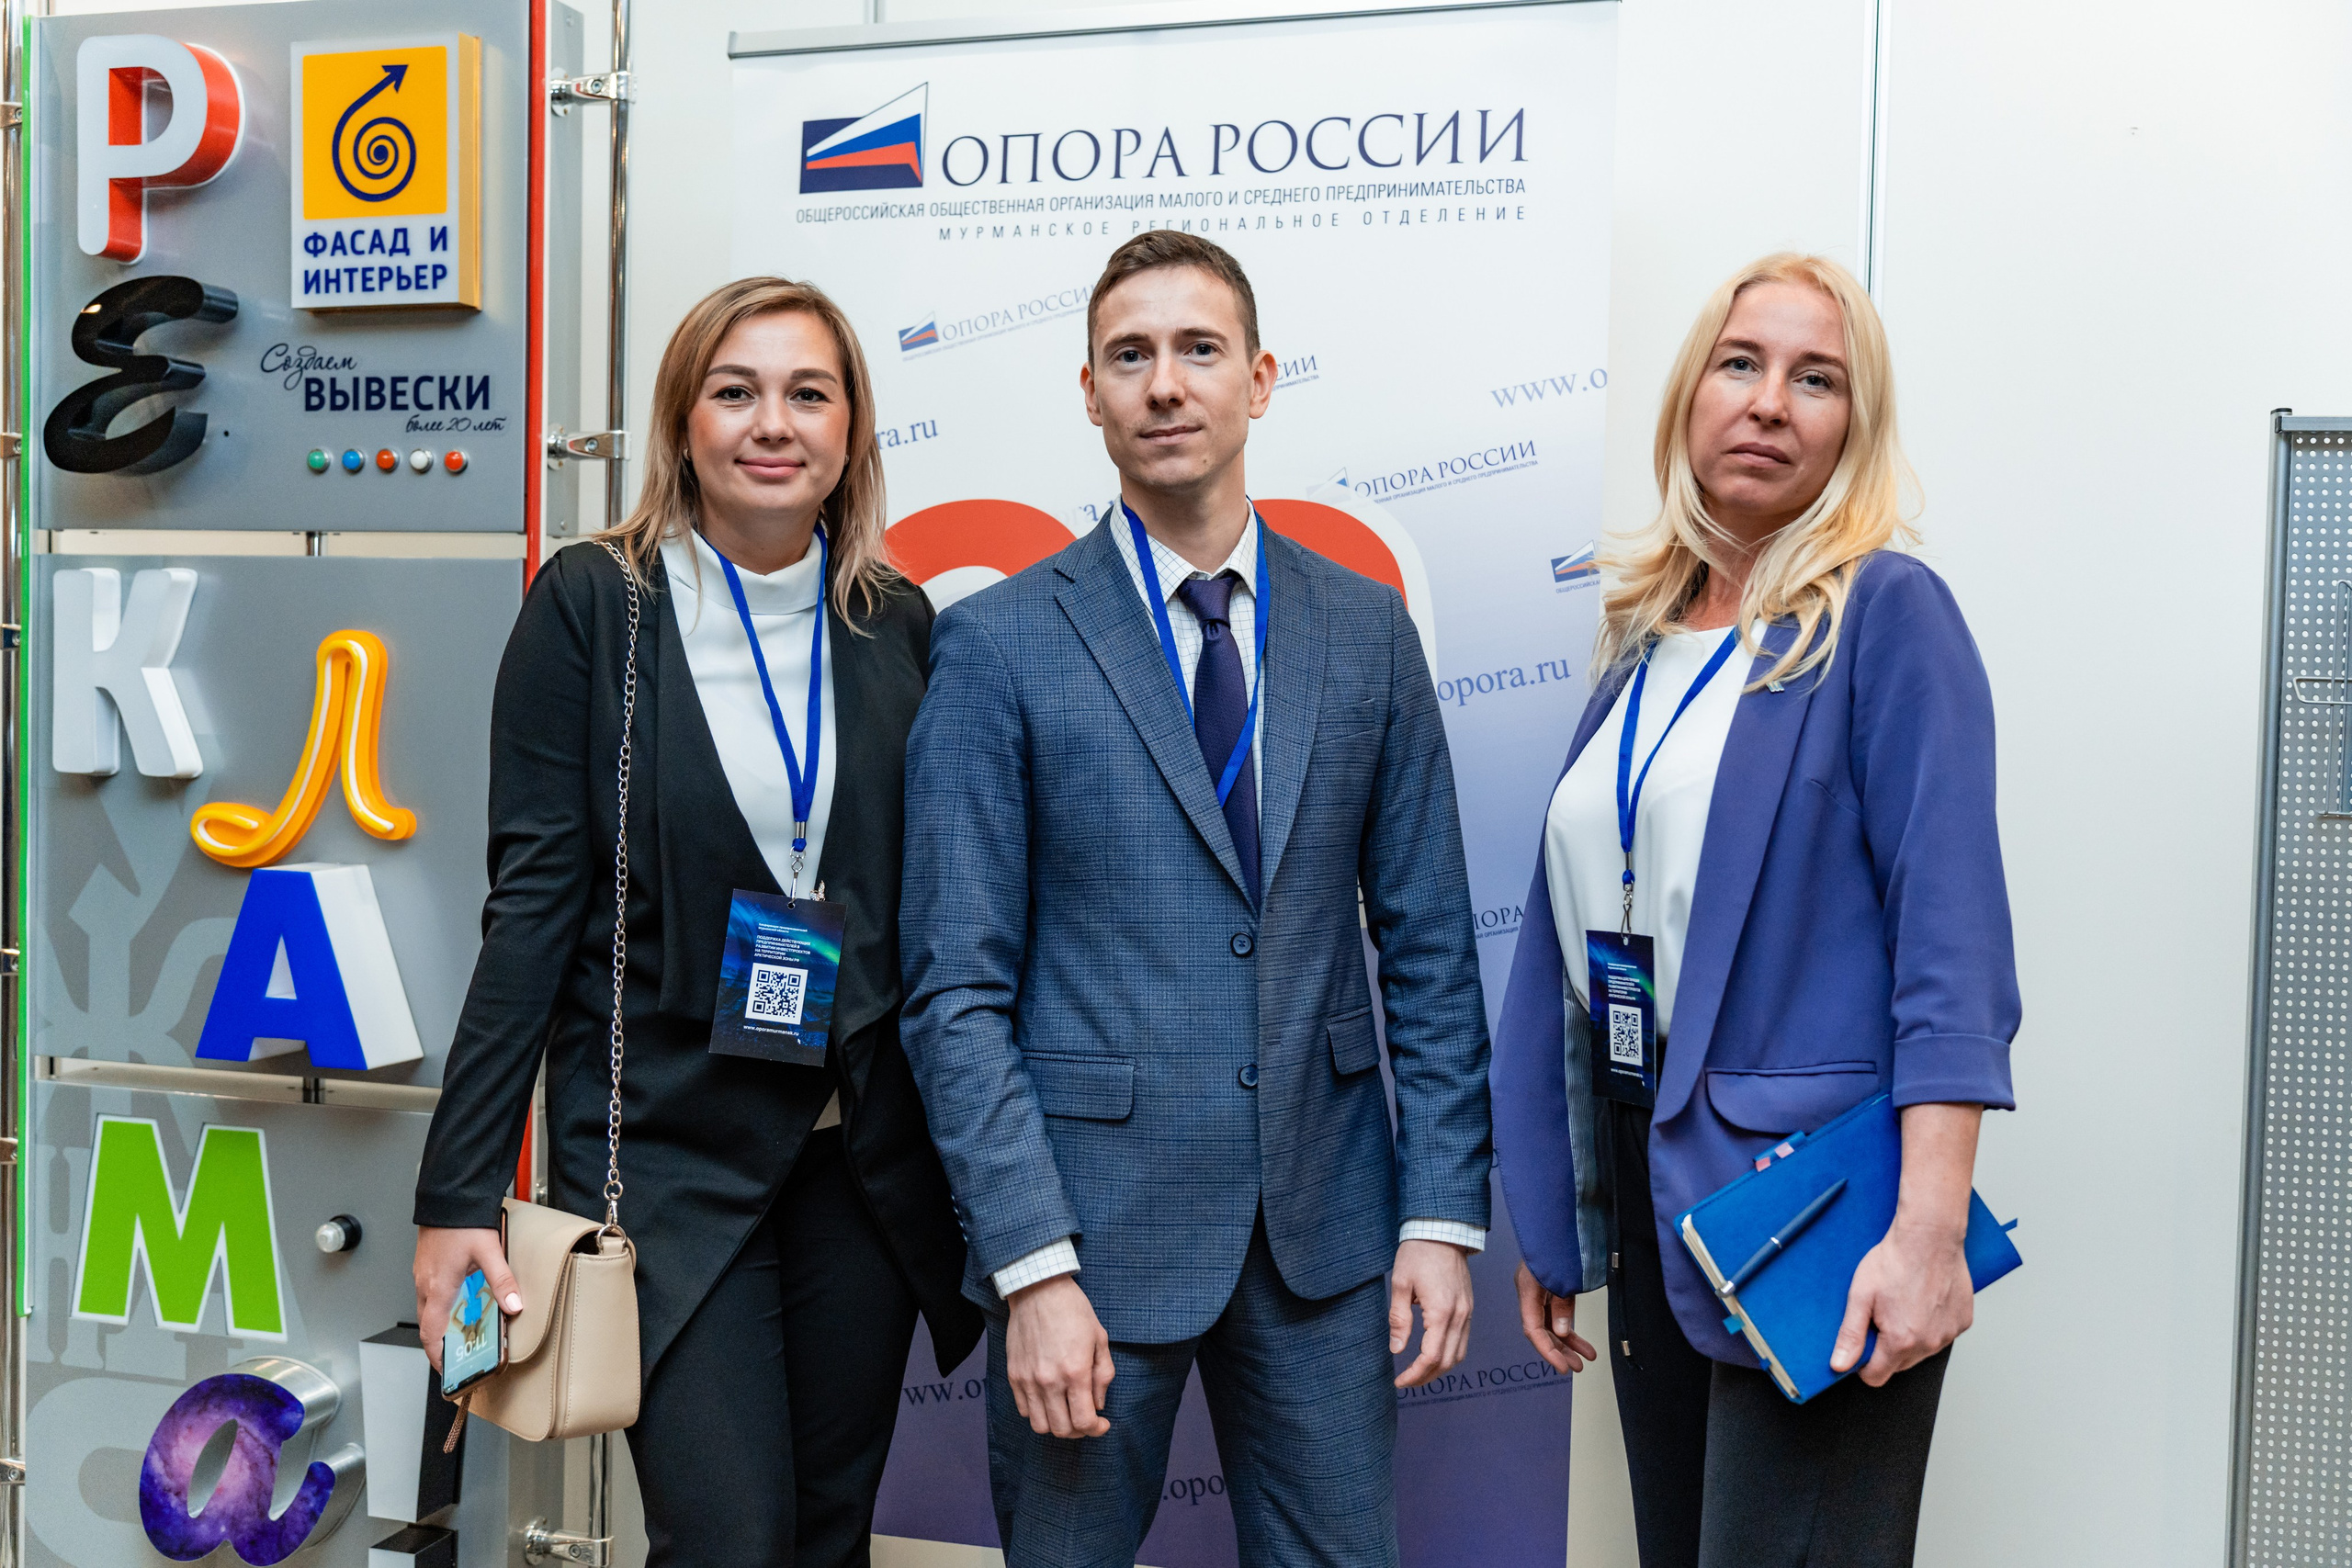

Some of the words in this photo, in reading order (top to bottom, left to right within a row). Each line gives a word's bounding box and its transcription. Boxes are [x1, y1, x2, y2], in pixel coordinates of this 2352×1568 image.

[942, 126, 1190, 186] ОПОРА
[1208, 107, 1529, 175] РОССИИ
[797, 202, 924, 225] ОБЩЕРОССИЙСКАЯ
[930, 197, 1044, 219] ОБЩЕСТВЕННАЯ
[1049, 194, 1154, 212] ОРГАНИЗАЦИЯ
[1159, 191, 1223, 208] МАЛОГО
[1228, 190, 1238, 206] И
[1244, 186, 1320, 206] СРЕДНЕГО
[1326, 178, 1526, 202] ПРЕДПРИНИМАТЕЛЬСТВА
[303, 228, 410, 257] ФАСАД
[430, 226, 447, 252] И
[939, 221, 1109, 241] МУРМАНСКОЕ
[1132, 212, 1339, 233] РЕГИОНАЛЬНОЕ
[1363, 206, 1525, 226] ОТДЕЛЕНИЕ
[304, 264, 447, 295] ИНТЕРЬЕР
[943, 310, 1014, 341] ОПОРА
[260, 343, 357, 390] Создаем
[304, 375, 490, 412] ВЫВЕСКИ
[406, 414, 444, 433] более
[446, 417, 471, 432] 20
[473, 417, 506, 432] лет
[1354, 466, 1434, 498] ОПОРА
[1438, 440, 1536, 479] РОССИИ
[1437, 659, 1572, 706] opora.ru
[1477, 1360, 1557, 1388] РОССИ
